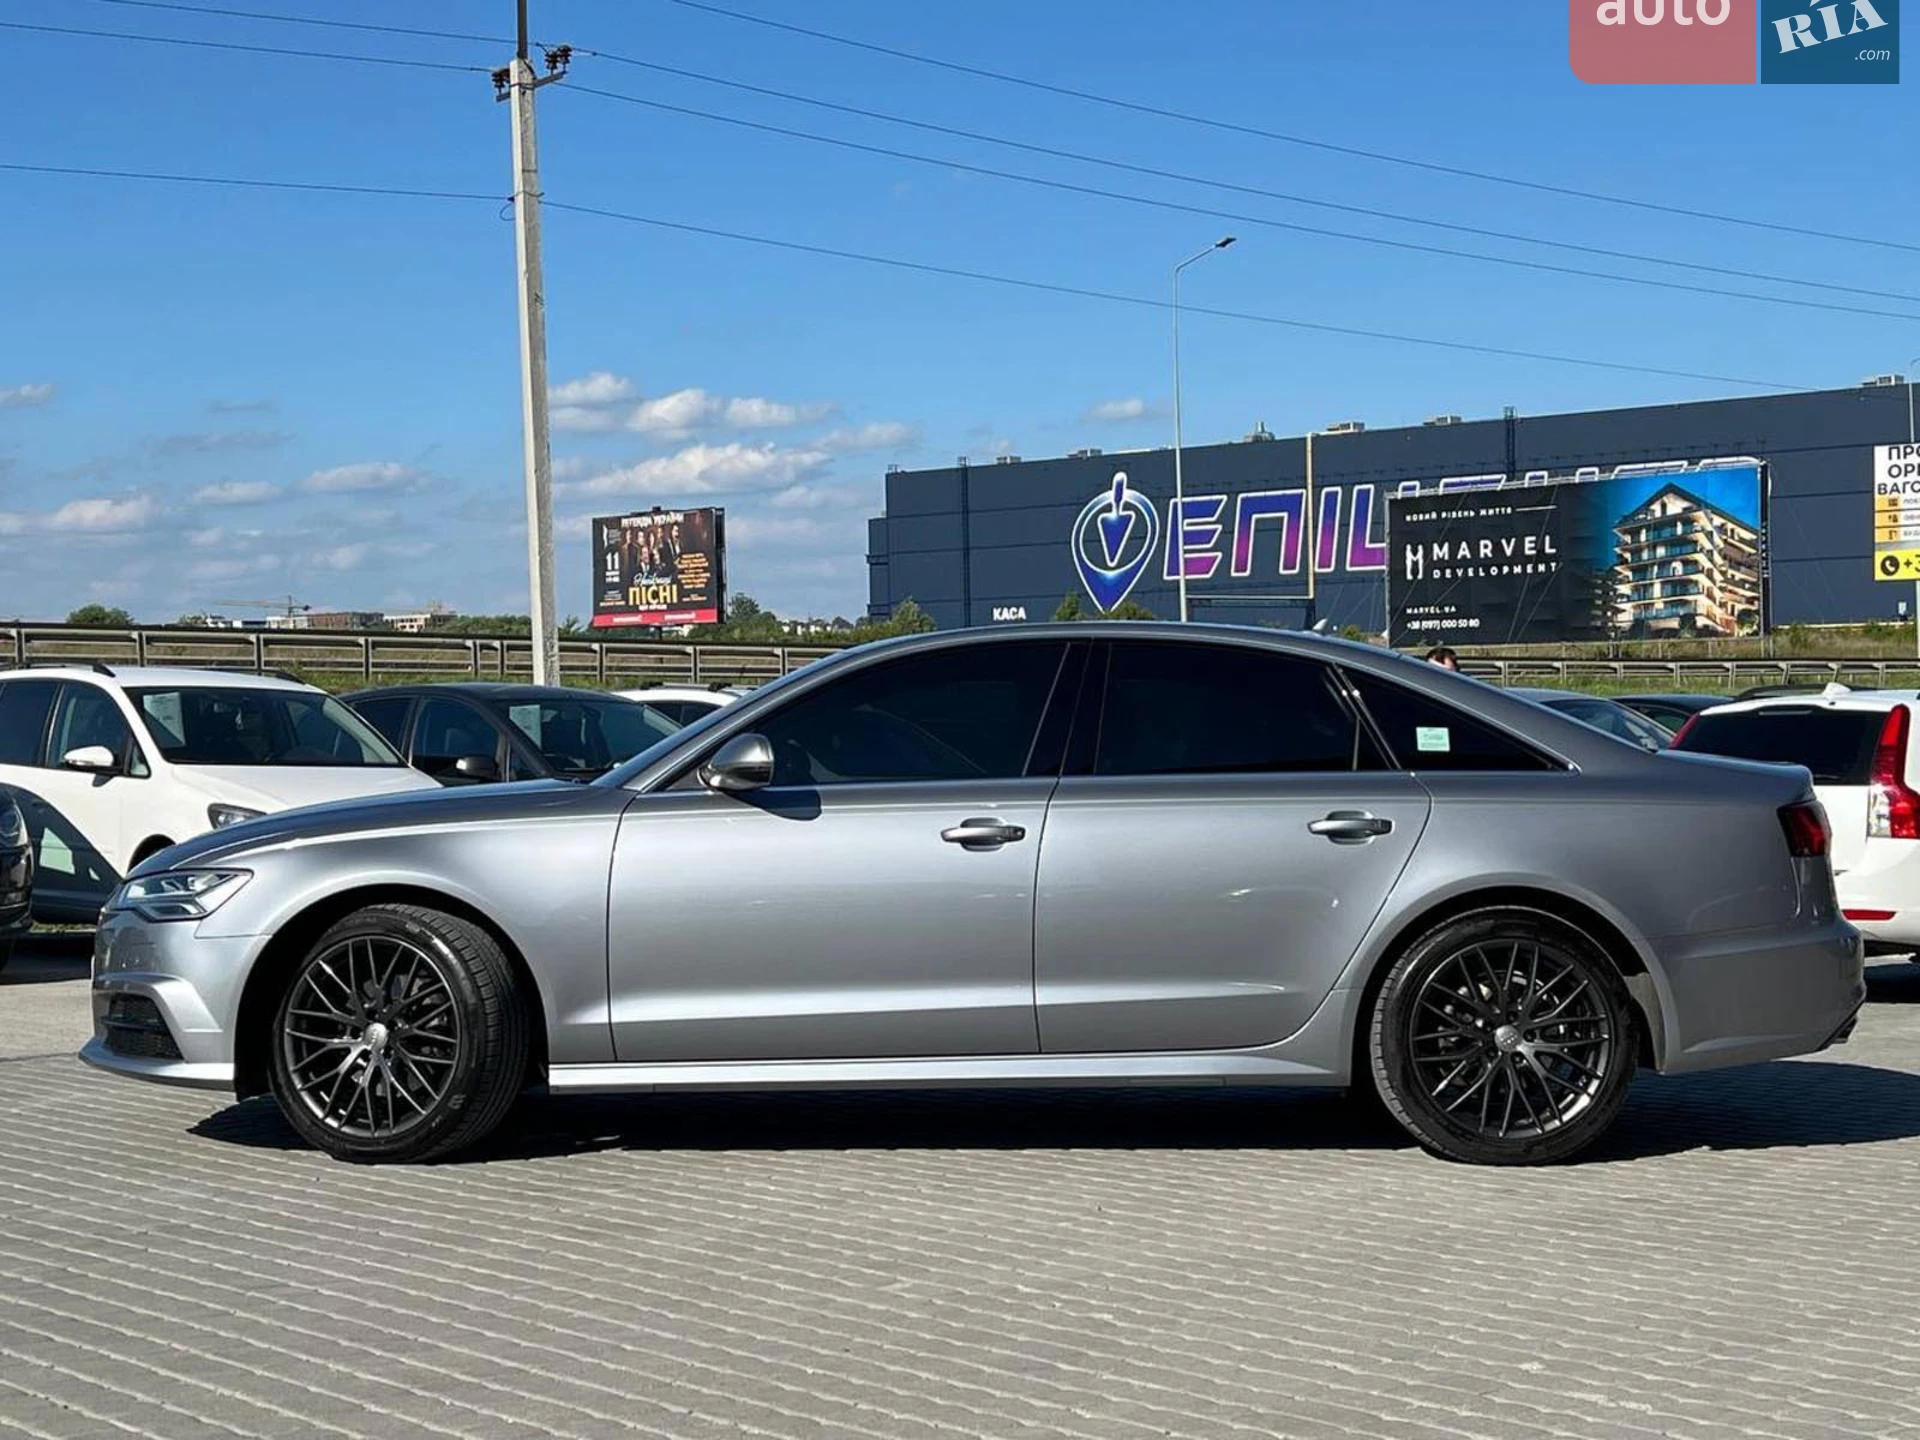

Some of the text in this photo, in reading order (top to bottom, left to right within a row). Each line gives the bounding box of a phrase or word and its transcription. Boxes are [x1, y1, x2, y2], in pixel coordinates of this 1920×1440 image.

[1405, 506, 1513, 522] НОВИЙ РІВЕНЬ ЖИТТЯ
[1432, 535, 1557, 561] MARVEL
[606, 551, 620, 571] 11
[1432, 562, 1557, 579] DEVELOPMENT
[628, 584, 678, 606] ПІСНІ
[993, 606, 1027, 621] КАСА
[1441, 619, 1457, 629] 000
